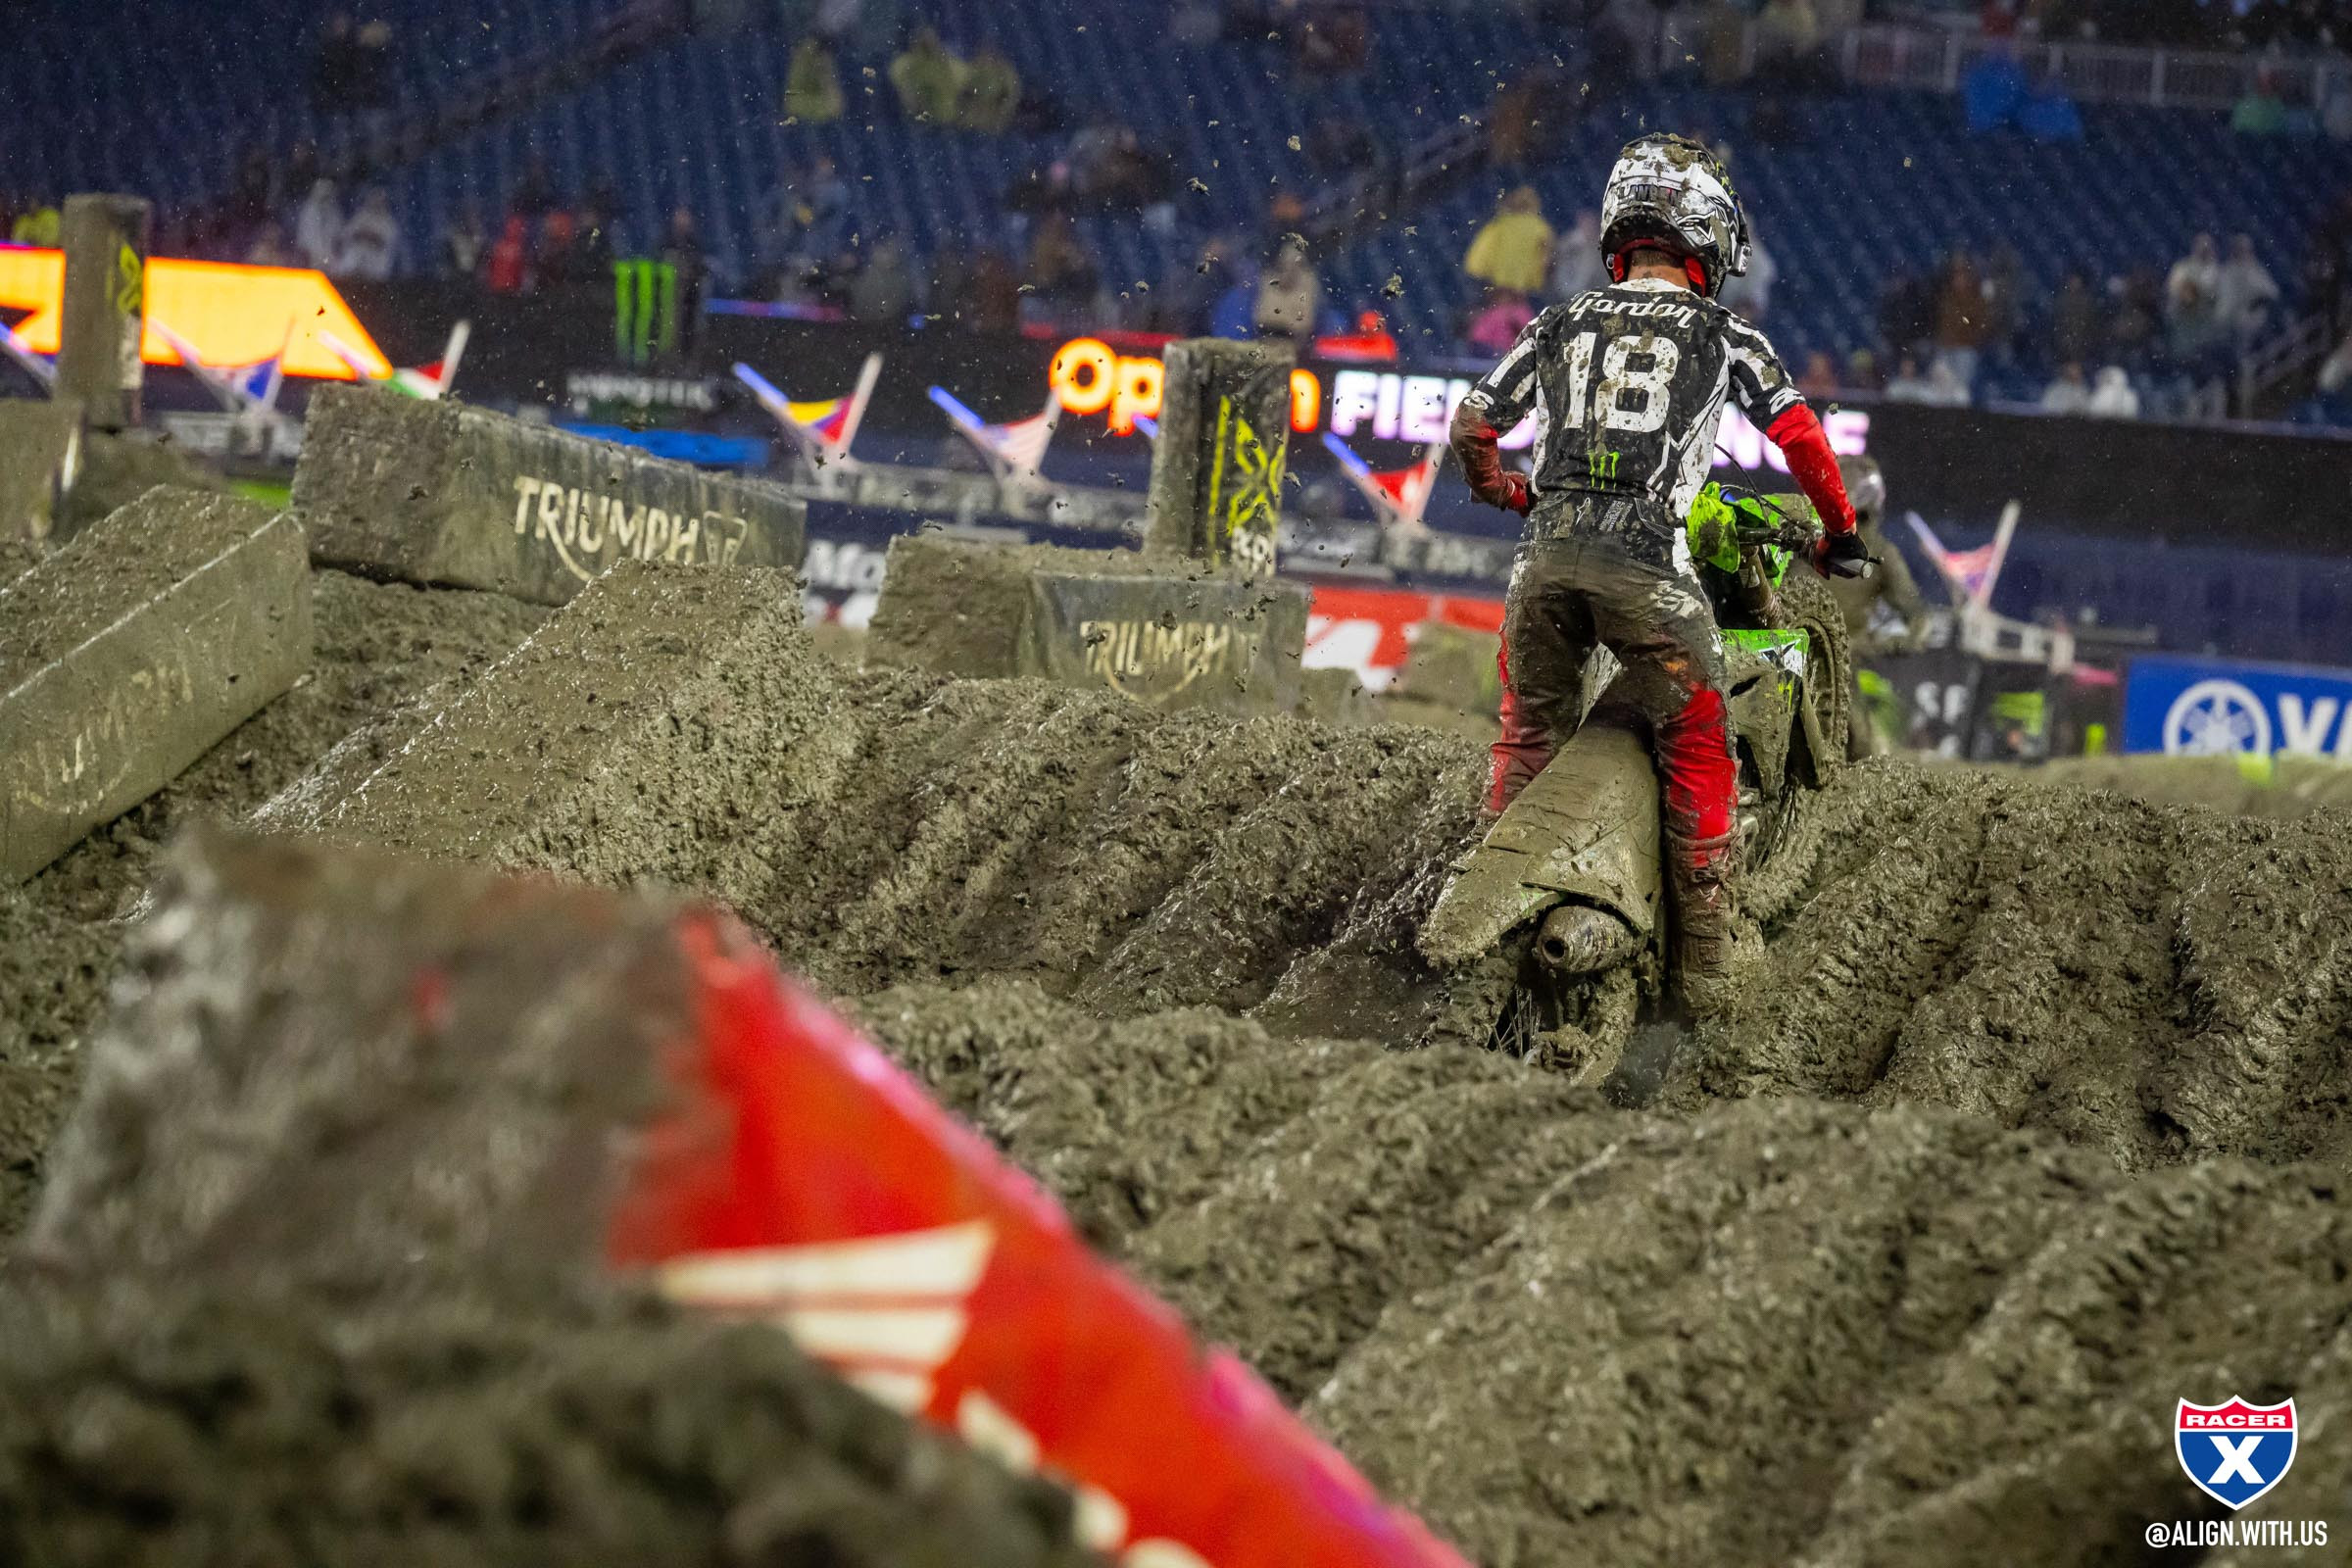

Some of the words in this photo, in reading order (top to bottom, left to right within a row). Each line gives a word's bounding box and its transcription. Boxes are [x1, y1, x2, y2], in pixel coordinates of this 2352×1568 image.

[1568, 292, 1697, 328] Gordon
[1049, 336, 1321, 437] Opn
[1564, 332, 1679, 432] 18
[514, 474, 700, 580] TRIUMPH
